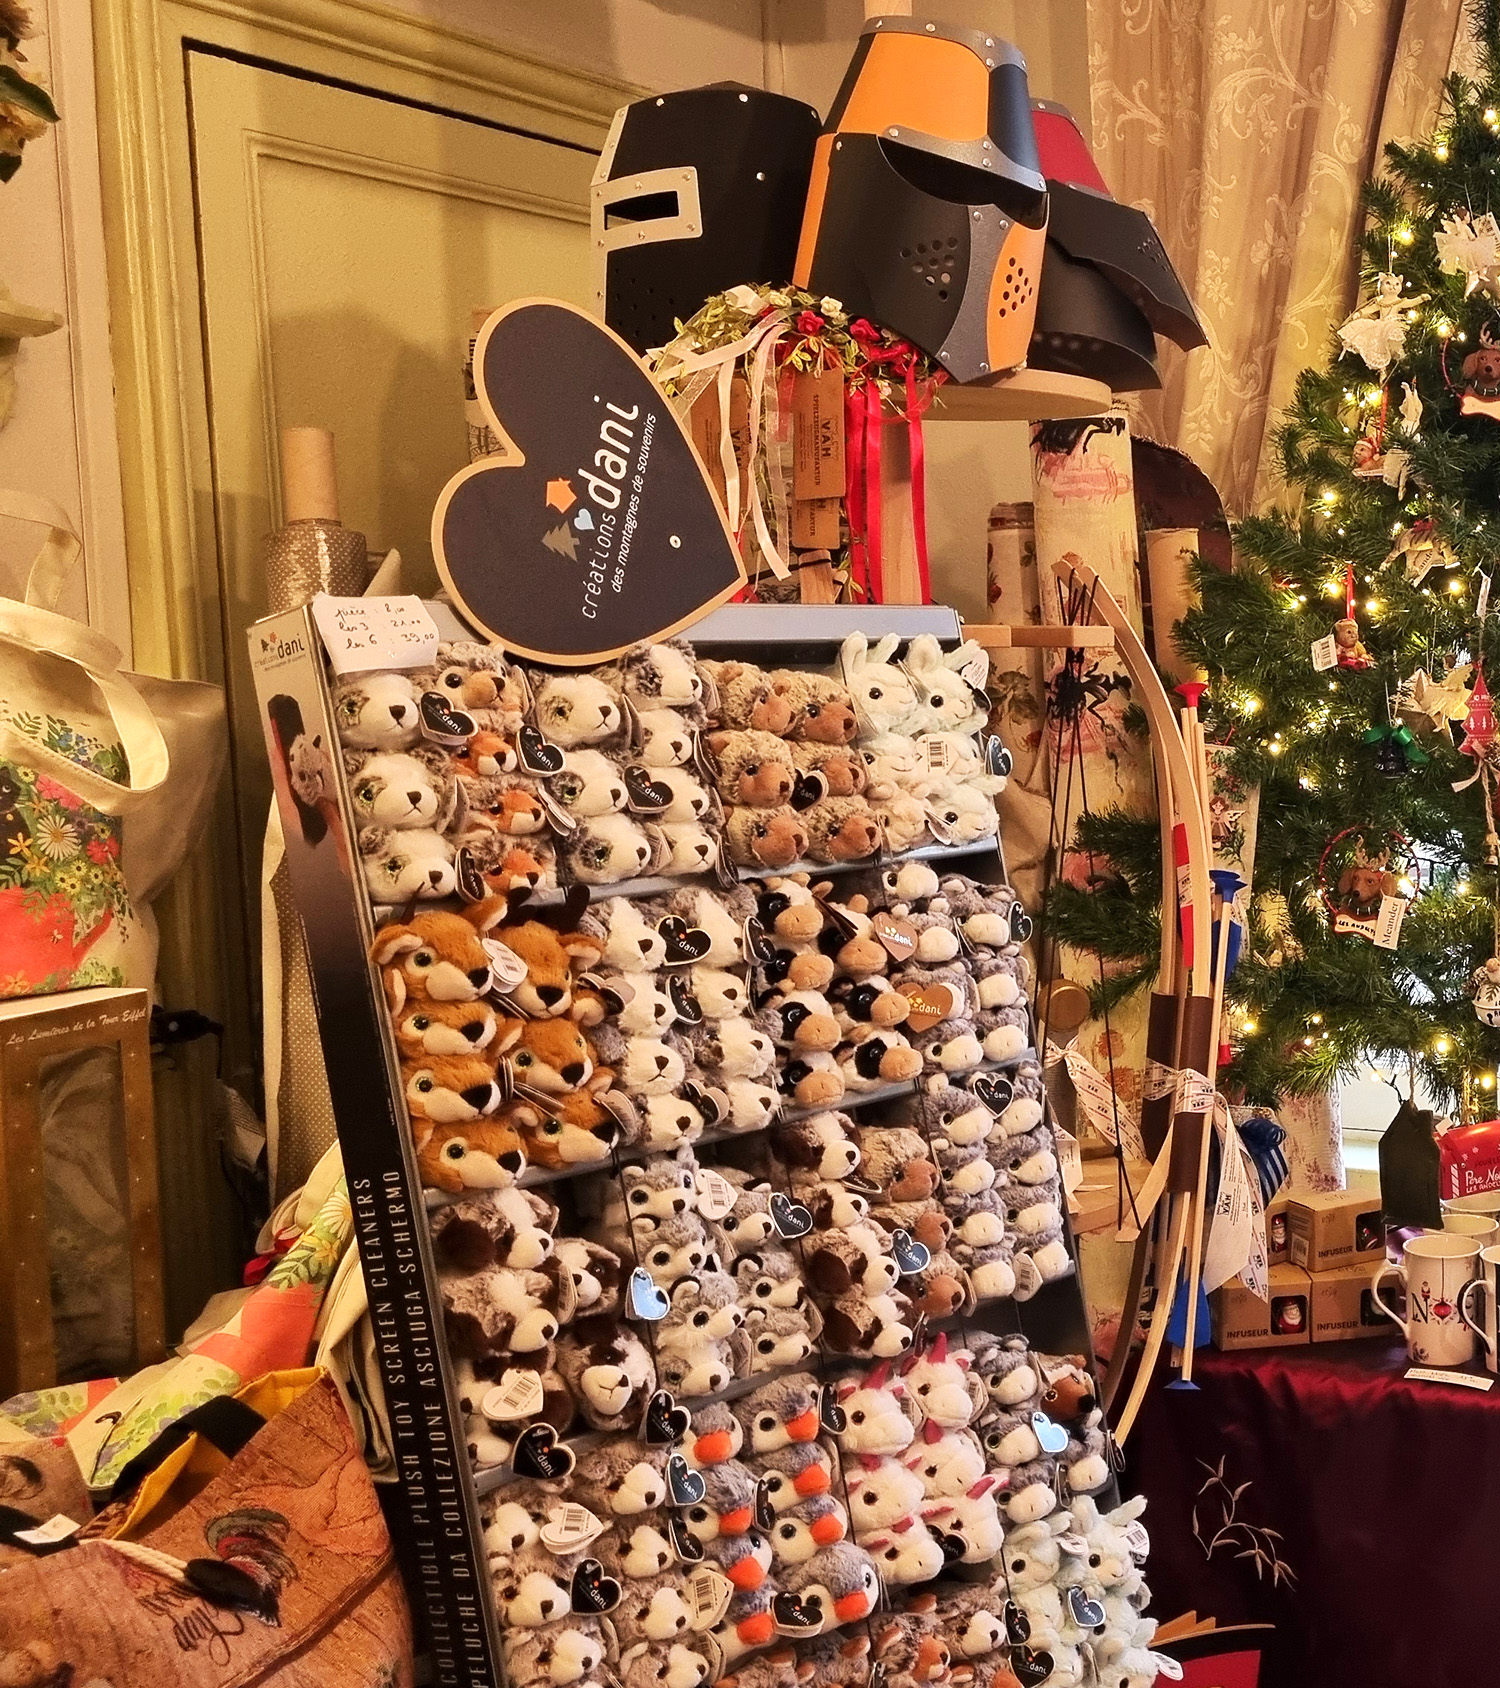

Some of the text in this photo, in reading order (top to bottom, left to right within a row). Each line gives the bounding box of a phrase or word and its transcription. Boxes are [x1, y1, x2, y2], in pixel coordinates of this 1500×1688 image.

[820, 420, 831, 457] VAH
[578, 394, 639, 510] dani
[612, 413, 657, 593] des montagnes de souvenirs
[582, 512, 616, 619] créations
[359, 622, 369, 631] 3
[277, 633, 305, 660] dani
[369, 633, 378, 645] 6
[401, 632, 435, 645] 39,00
[442, 713, 462, 734] dani
[536, 749, 555, 769] dani
[645, 786, 663, 805] dani
[1338, 920, 1349, 928] LES
[1382, 901, 1399, 945] Meander
[679, 939, 699, 957] dani
[894, 932, 912, 947] dani
[681, 999, 696, 1018] dani
[919, 1002, 941, 1015] dani
[6, 1032, 25, 1045] Les
[72, 1021, 84, 1032] de
[86, 1019, 96, 1029] la
[993, 1090, 1010, 1100] dani
[1466, 1185, 1478, 1193] LES
[1223, 1194, 1231, 1214] VAH
[788, 1212, 805, 1229] dani
[1318, 1246, 1353, 1259] INFUSEUR
[1227, 1328, 1269, 1339] INFUSEUR
[1317, 1320, 1358, 1331] INFUSEUR
[353, 1178, 458, 1685] COLLECTIBLE PLUSH TOY SCREEN CLEANERS
[383, 1171, 489, 1688] PELUCHE DA COLLEZIONE ASCIUGA-SCHERMO
[661, 1421, 676, 1438] dani
[537, 1453, 554, 1476] dani
[683, 1481, 698, 1499] dani
[590, 1589, 606, 1610] dani
[793, 1609, 811, 1626] dani
[1029, 1662, 1047, 1675] dani
